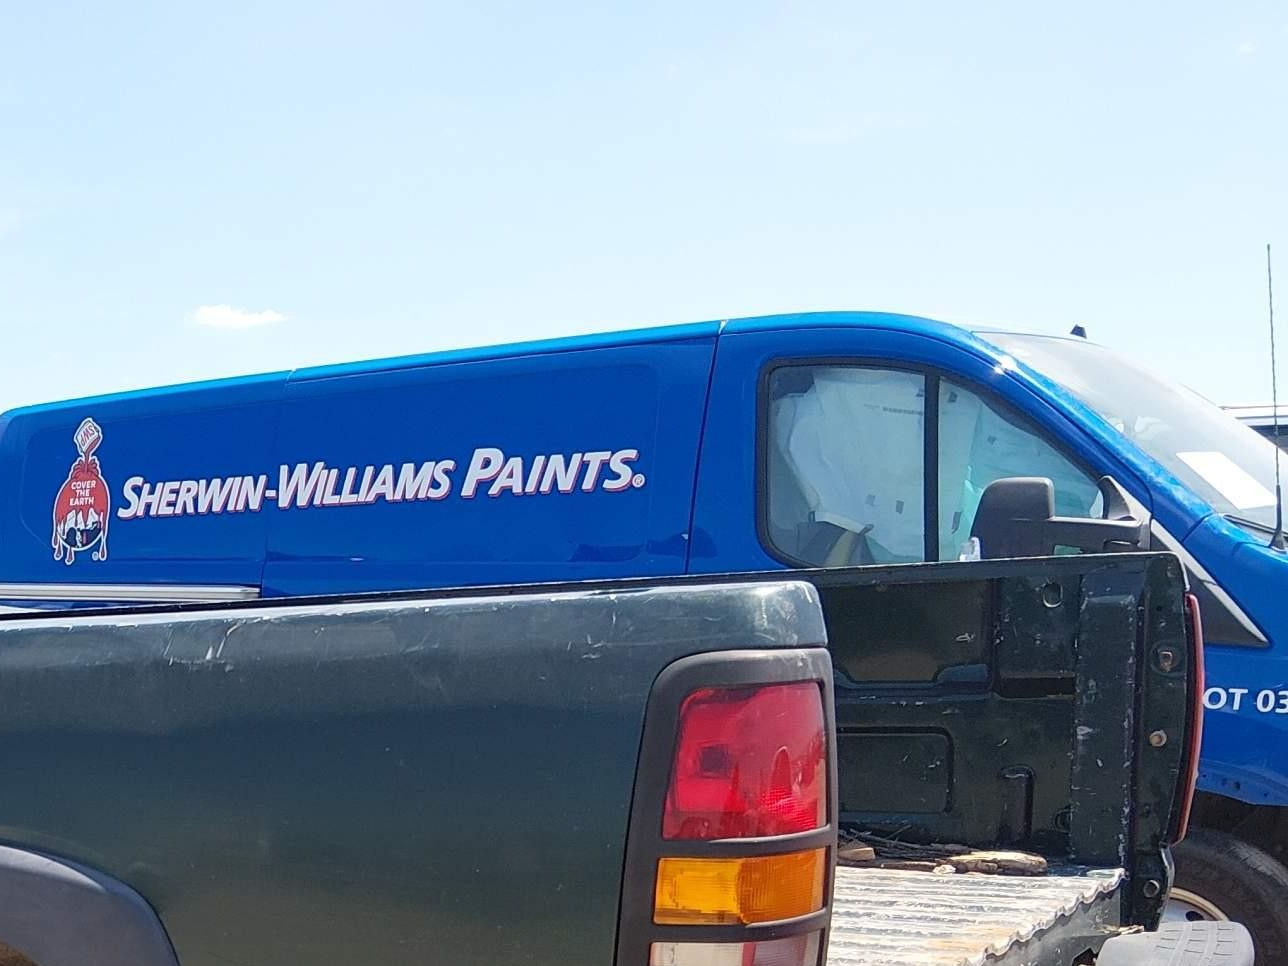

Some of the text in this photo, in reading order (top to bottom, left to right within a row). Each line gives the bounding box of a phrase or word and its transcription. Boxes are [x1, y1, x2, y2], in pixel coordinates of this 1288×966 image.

[71, 480, 96, 490] COVER
[75, 489, 90, 497] THE
[117, 460, 456, 520] SHERWIN-WILLIAMS
[69, 497, 94, 506] EARTH
